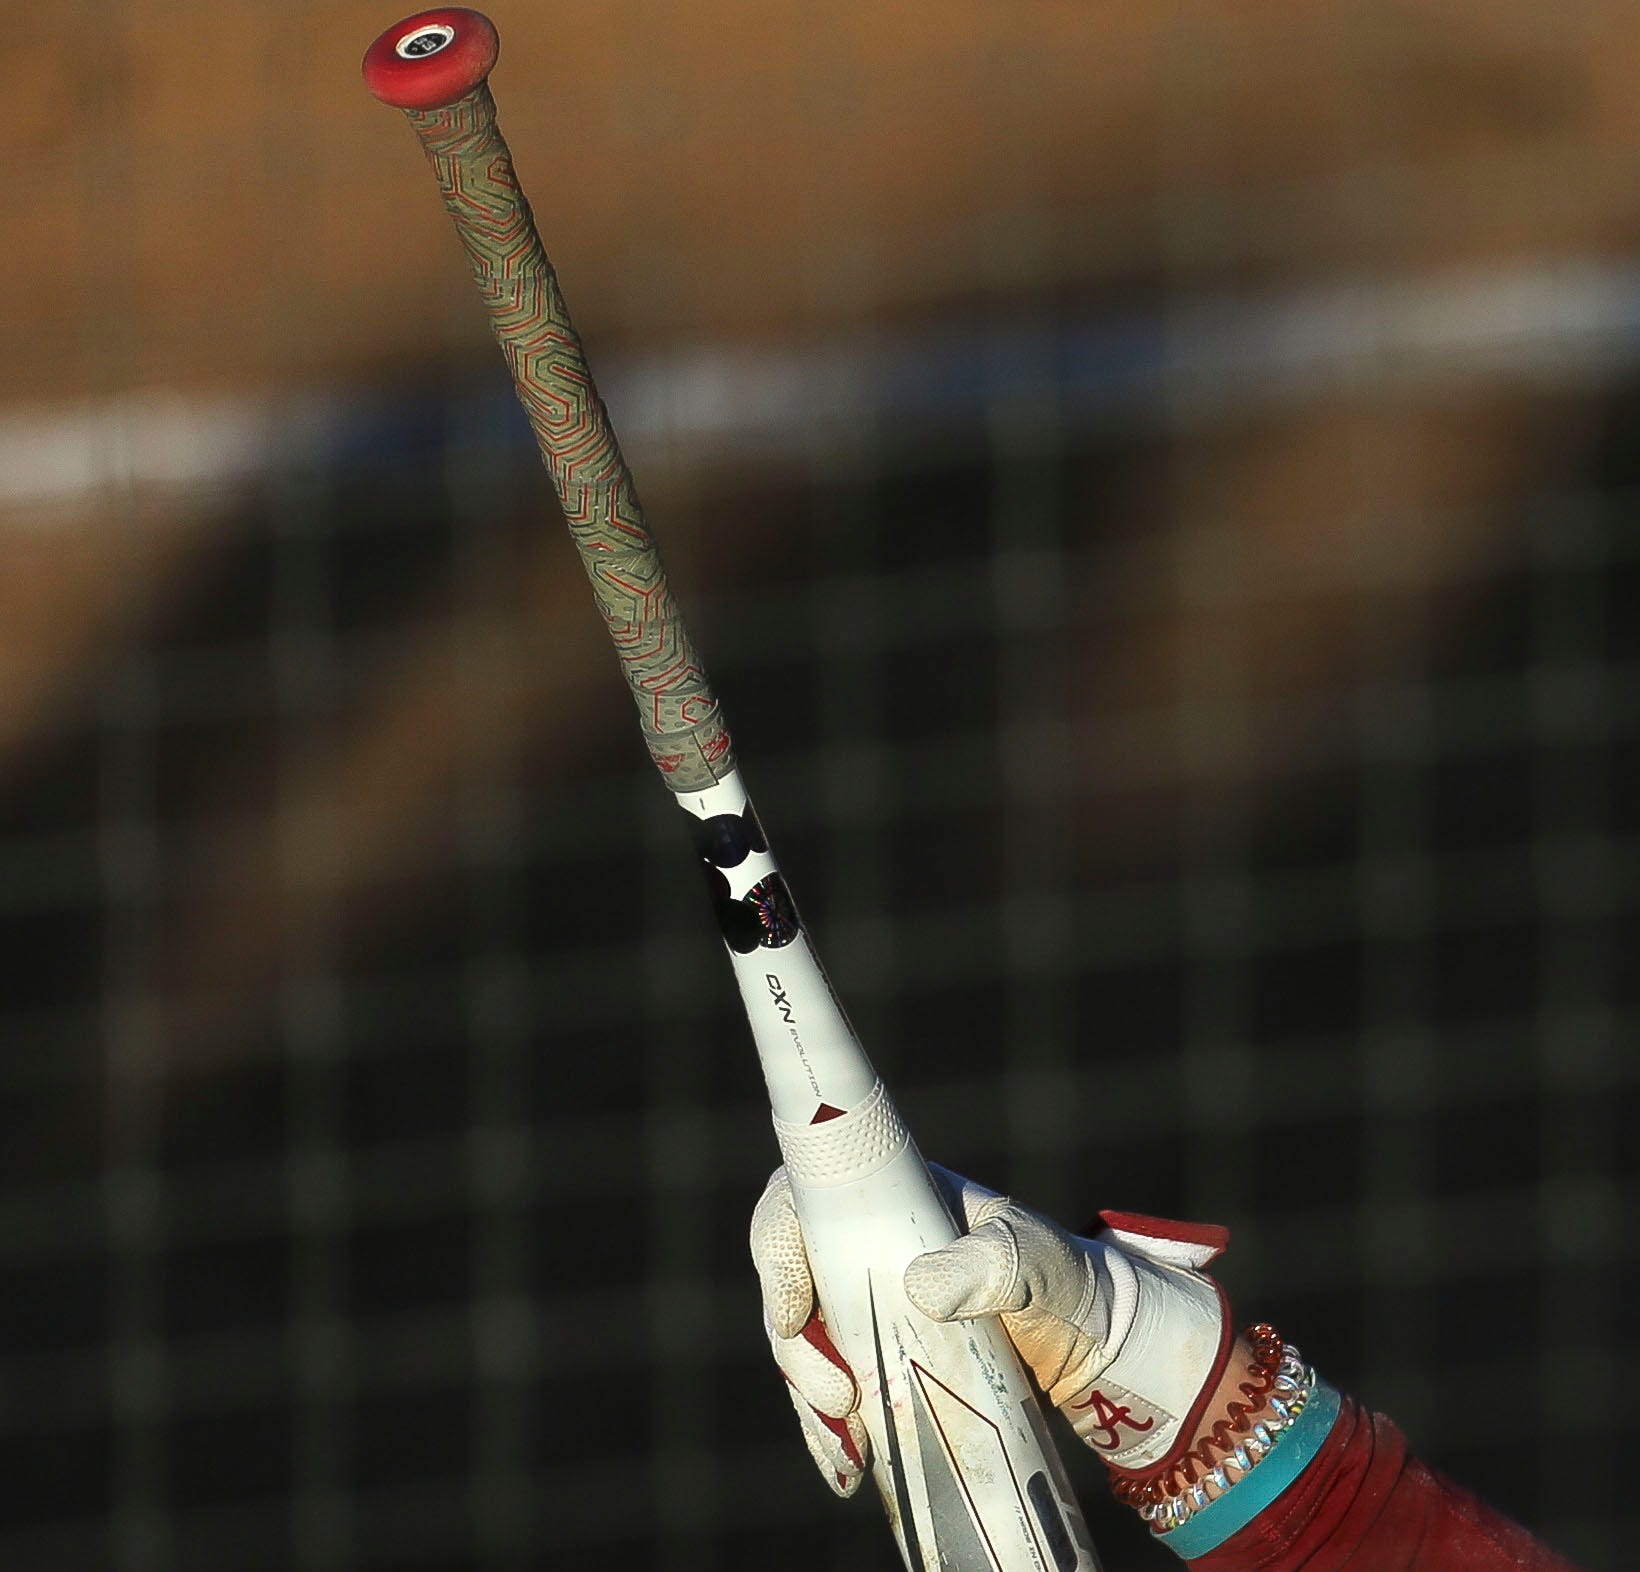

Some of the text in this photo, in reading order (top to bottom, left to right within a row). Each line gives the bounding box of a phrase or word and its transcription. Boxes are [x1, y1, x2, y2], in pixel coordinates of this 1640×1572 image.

[765, 973, 822, 1097] CXN EVOLUTION
[1071, 1389, 1154, 1451] A
